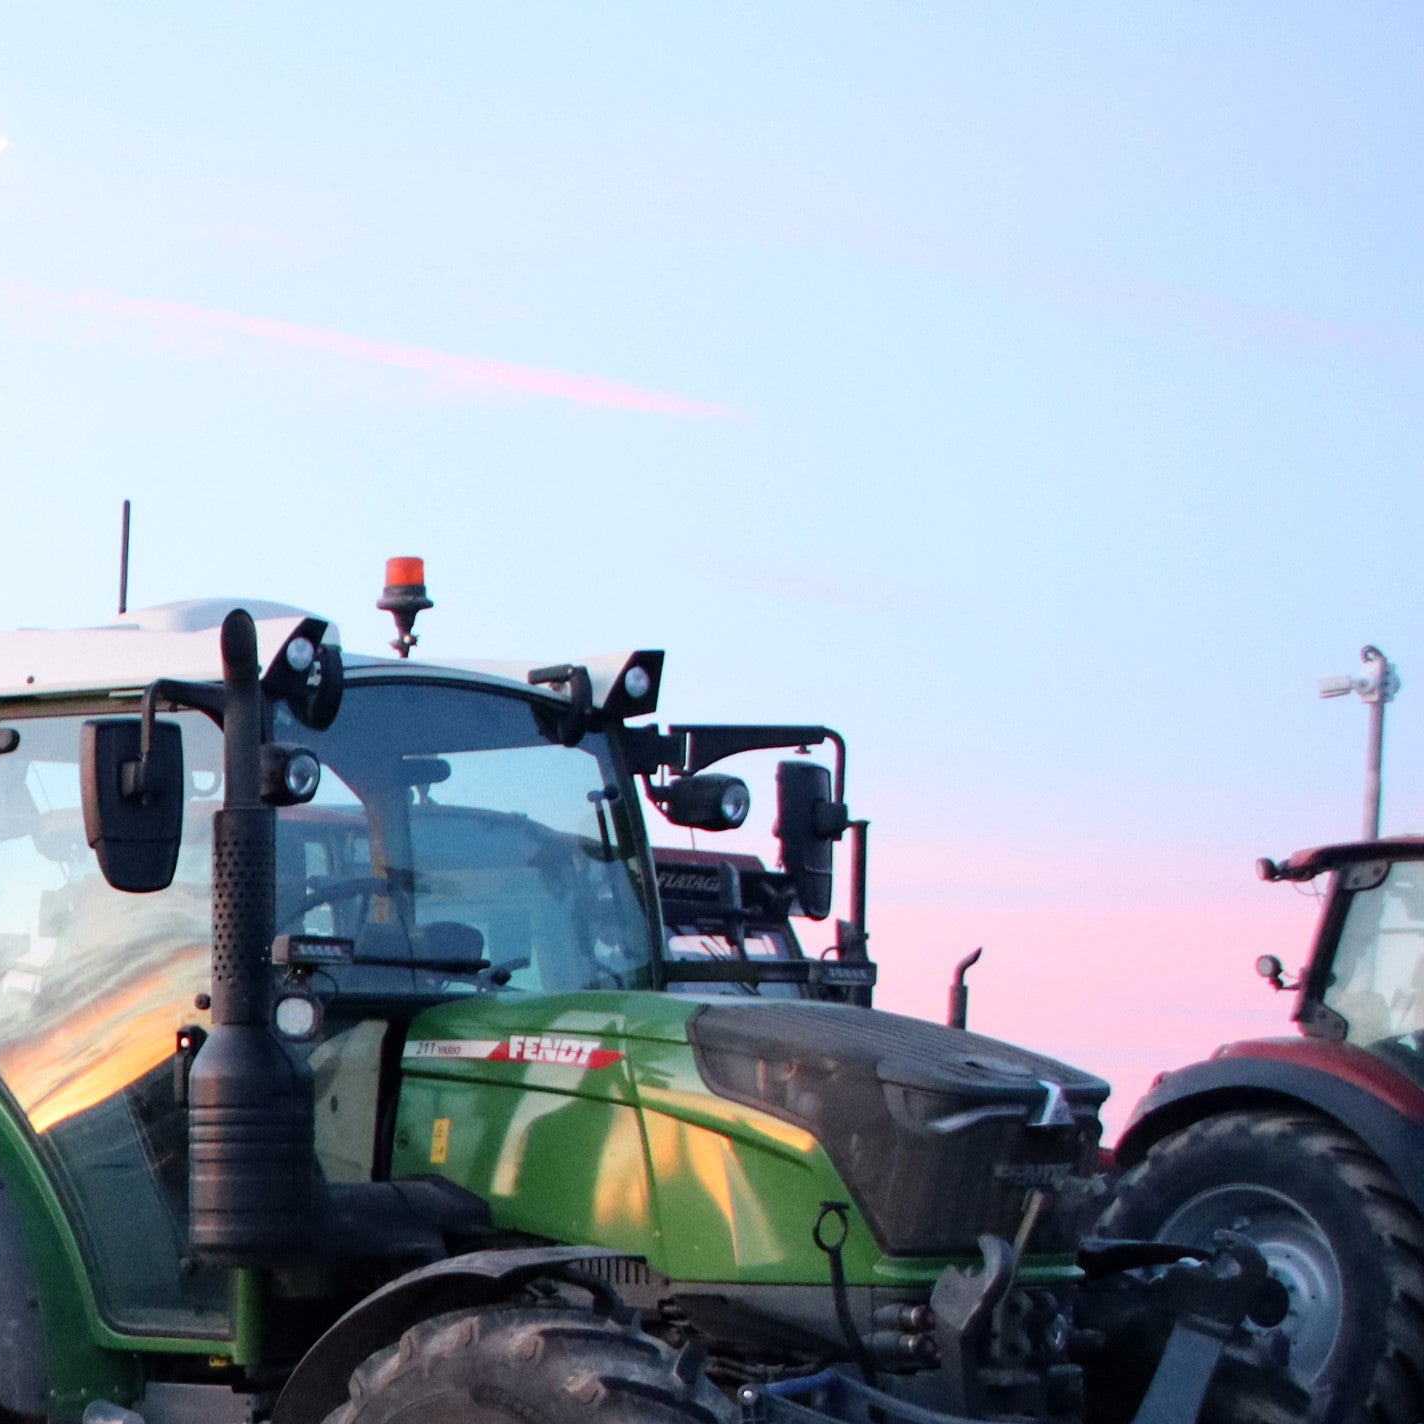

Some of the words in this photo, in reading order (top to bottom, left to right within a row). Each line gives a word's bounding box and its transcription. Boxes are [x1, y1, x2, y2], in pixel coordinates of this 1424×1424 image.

[416, 1042, 435, 1055] 211
[438, 1046, 461, 1055] VARIO
[509, 1034, 600, 1064] FENDT
